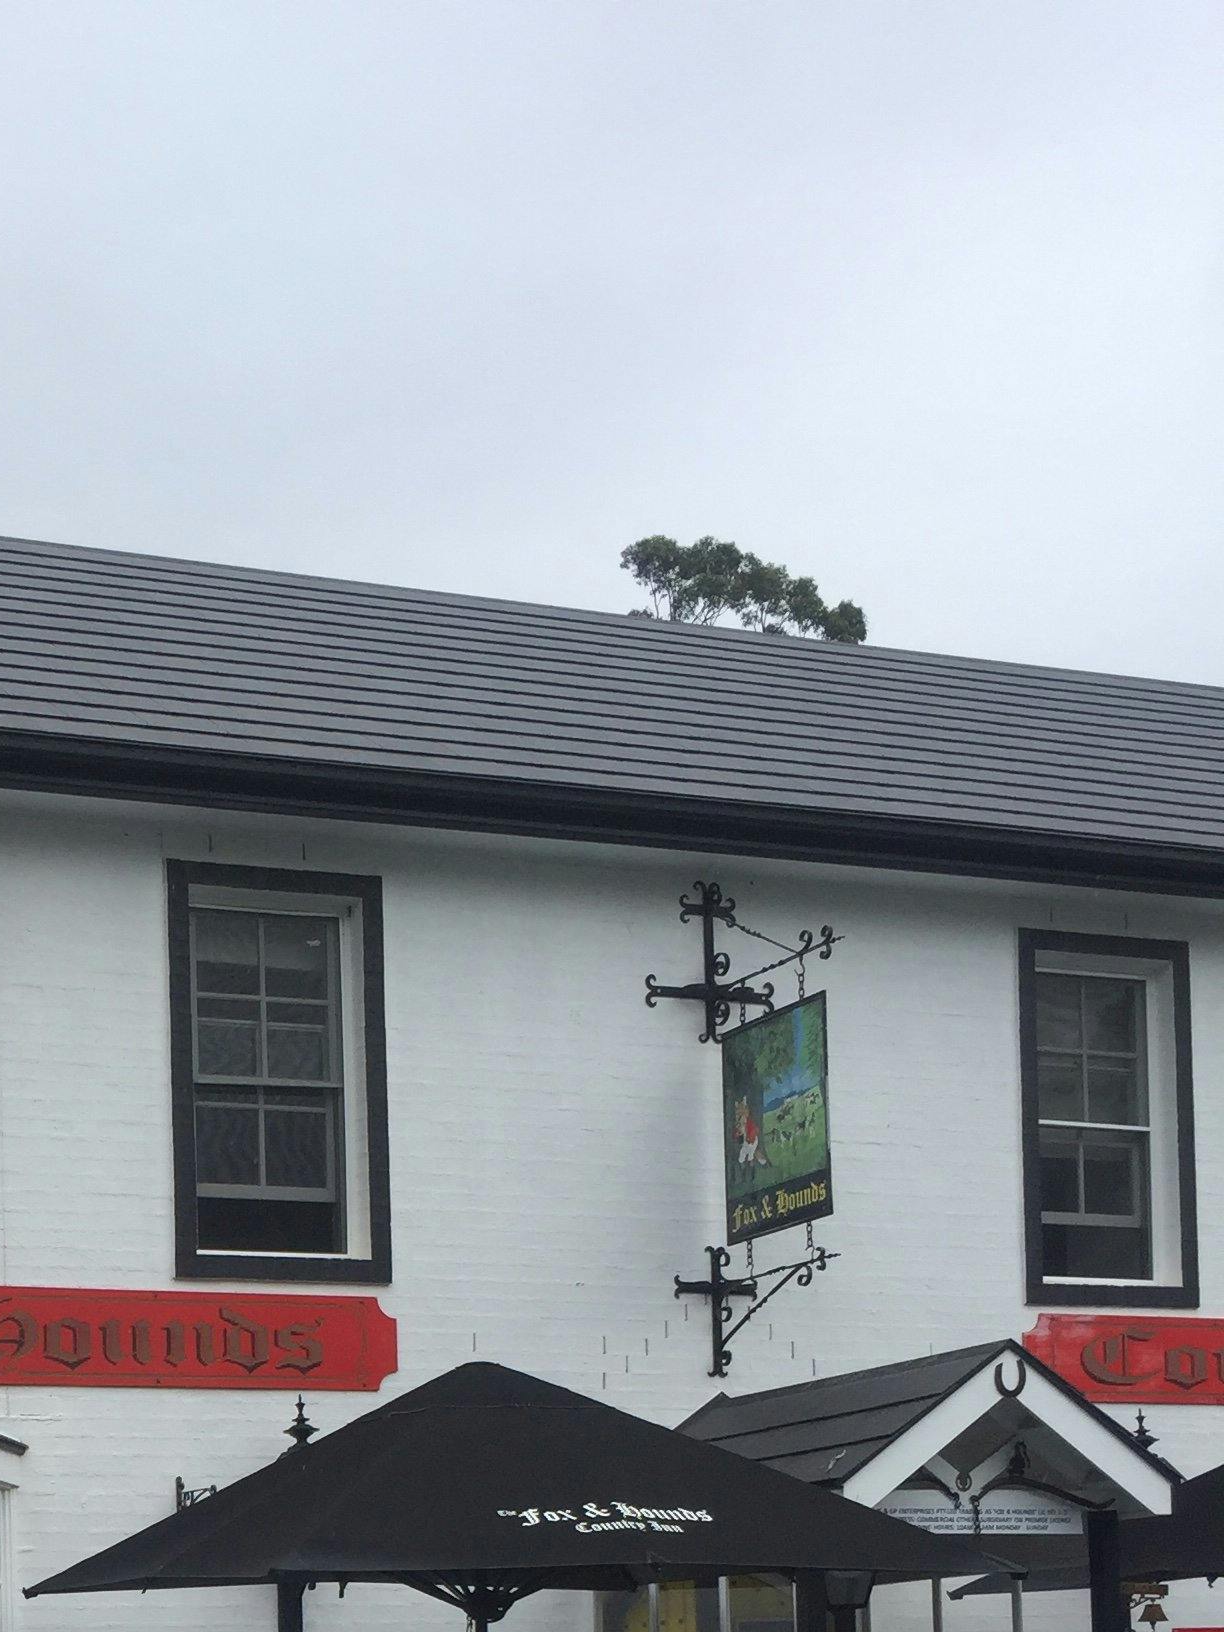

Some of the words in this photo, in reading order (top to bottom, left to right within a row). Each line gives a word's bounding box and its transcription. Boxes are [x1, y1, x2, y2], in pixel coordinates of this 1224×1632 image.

[732, 1203, 757, 1233] Fox
[760, 1195, 773, 1219] &
[776, 1182, 826, 1217] Hounds
[1080, 1327, 1224, 1390] Co
[518, 1508, 577, 1526] Fox
[582, 1502, 611, 1519] &
[610, 1501, 714, 1522] Hounds
[575, 1519, 646, 1533] Country
[647, 1520, 684, 1533] Inn
